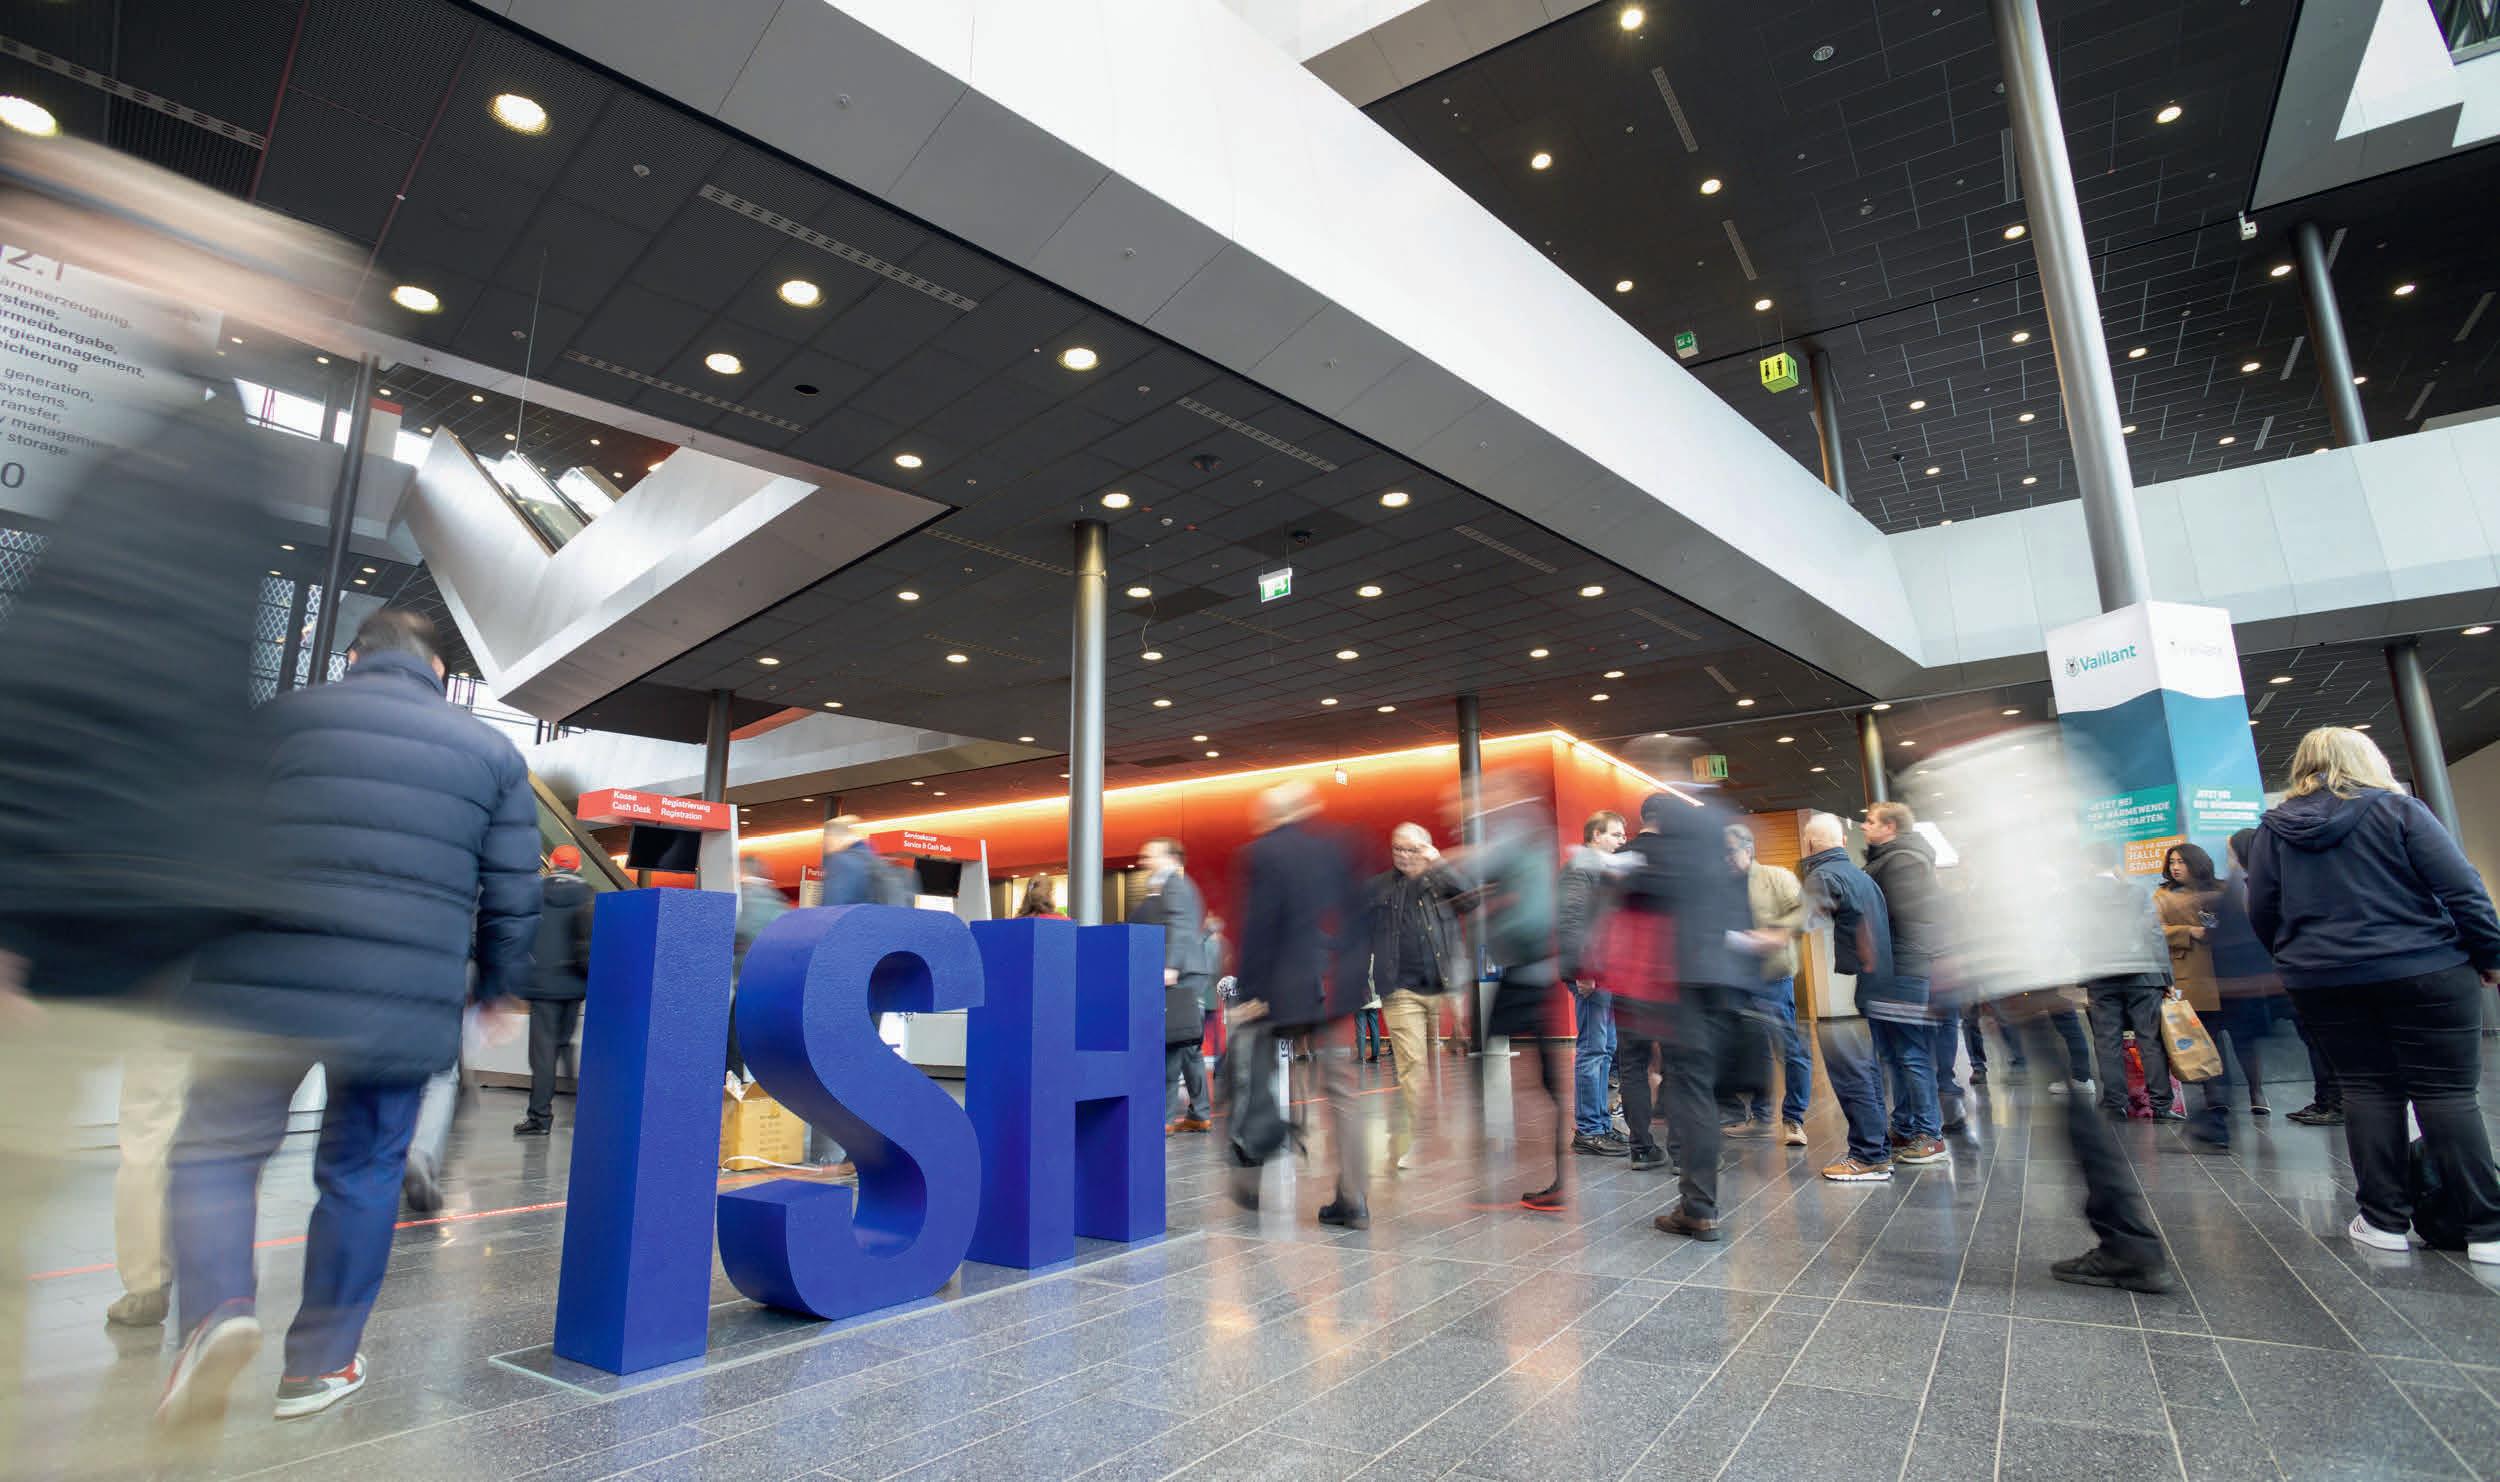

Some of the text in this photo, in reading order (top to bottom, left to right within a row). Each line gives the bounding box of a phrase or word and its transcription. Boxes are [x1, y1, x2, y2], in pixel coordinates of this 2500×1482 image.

[2079, 644, 2137, 671] Vaillant
[613, 790, 637, 801] Kasse
[612, 801, 651, 814] Cash Desk
[661, 797, 711, 813] Registrierung
[661, 807, 702, 821] Registration
[554, 887, 1166, 1376] ISH
